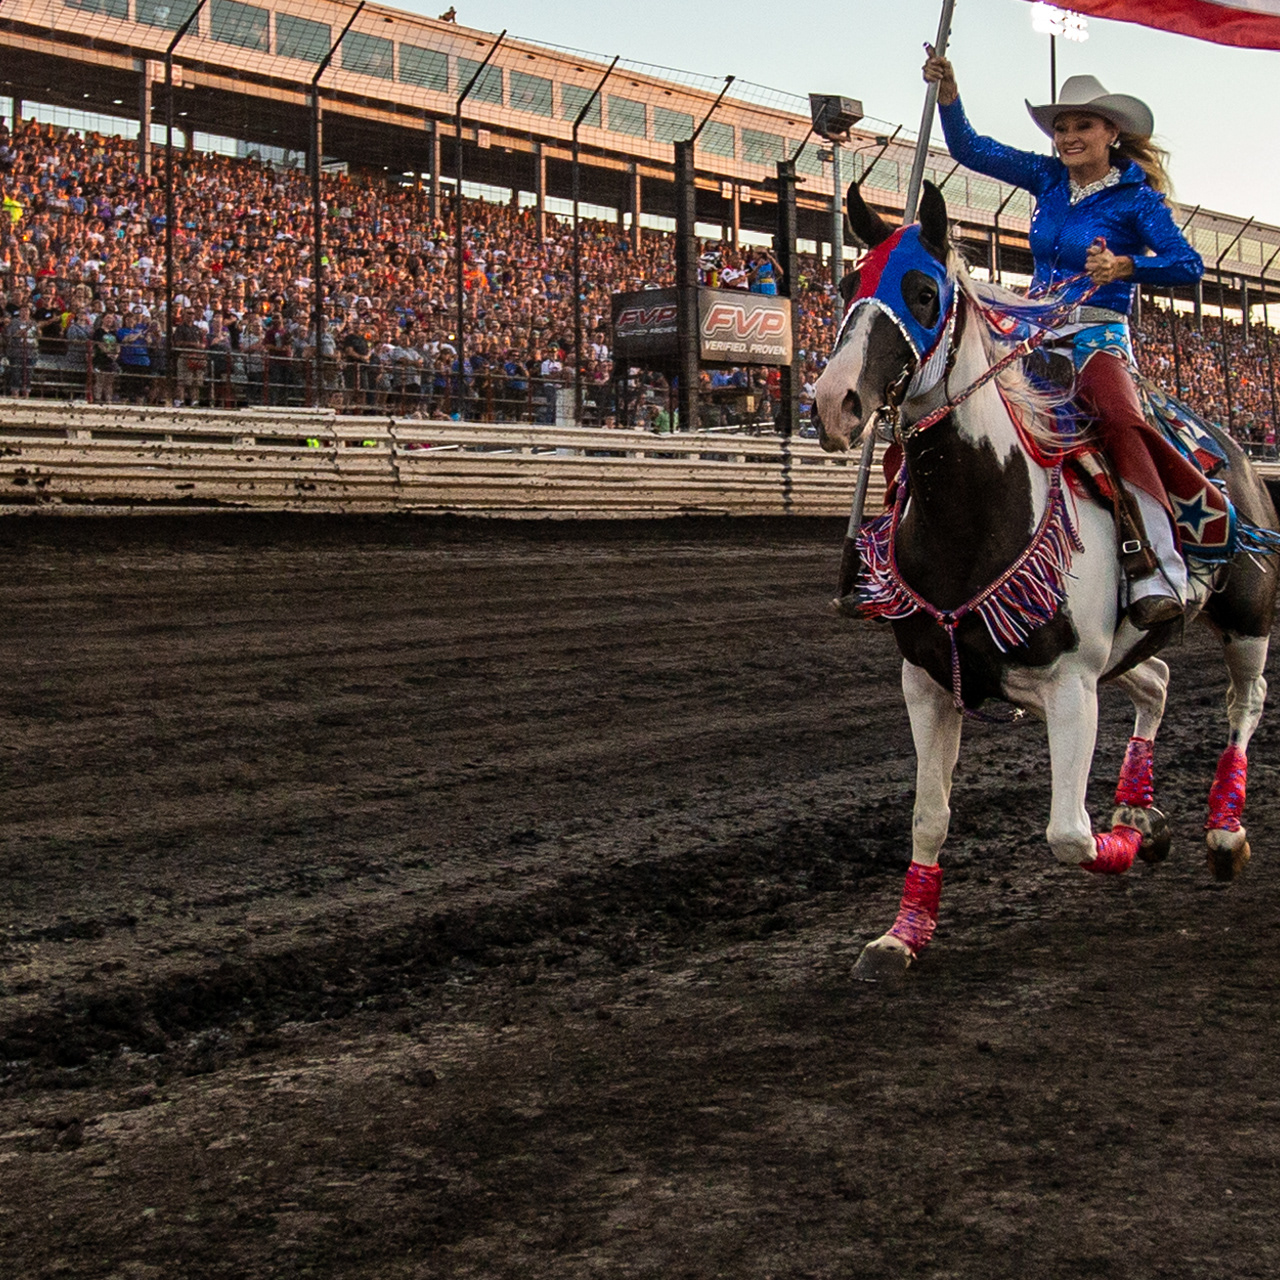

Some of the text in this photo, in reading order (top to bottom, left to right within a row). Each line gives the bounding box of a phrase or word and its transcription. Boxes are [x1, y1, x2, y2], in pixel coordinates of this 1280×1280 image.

[616, 305, 677, 328] FVP
[703, 303, 786, 340] FVP
[705, 340, 787, 356] VERIFIED. PROVEN.
